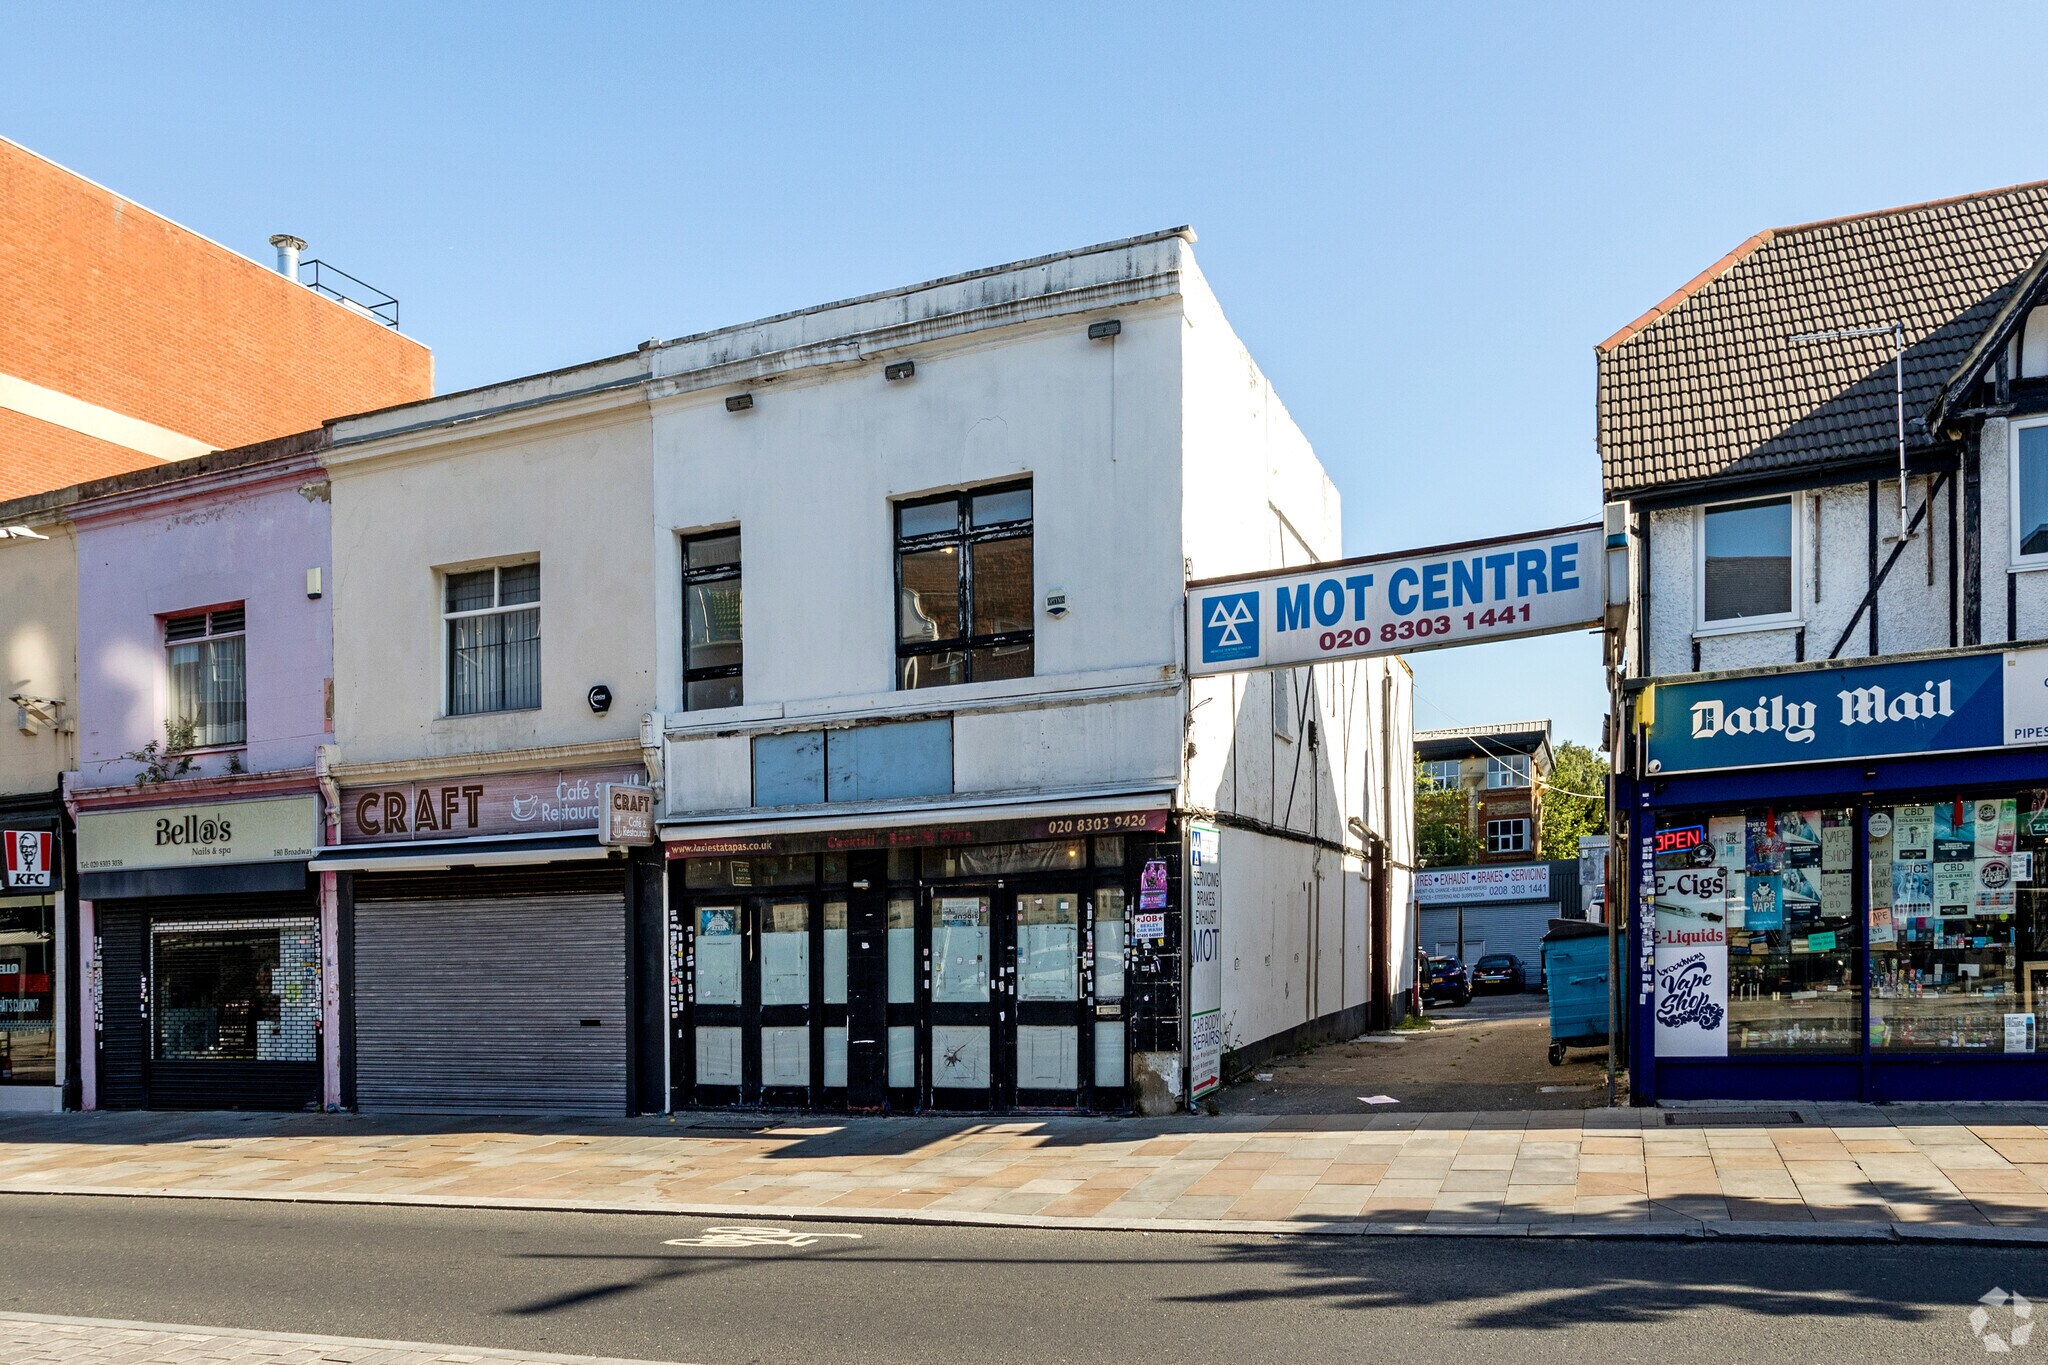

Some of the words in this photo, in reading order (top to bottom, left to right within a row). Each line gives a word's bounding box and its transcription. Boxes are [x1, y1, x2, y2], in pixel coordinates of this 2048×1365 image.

[1276, 574, 1373, 632] MOT
[1388, 542, 1579, 616] CENTRE
[1319, 627, 1371, 650] 020
[1380, 615, 1451, 642] 8303
[1463, 603, 1531, 630] 1441
[1690, 695, 1817, 744] Daily
[1836, 679, 1955, 726] Mail
[2014, 726, 2048, 739] PIPES
[556, 779, 590, 801] Café
[356, 785, 483, 836] CRAFT
[542, 803, 600, 822] Restaura
[613, 793, 650, 813] CRAFT
[1903, 807, 1925, 816] CBD
[629, 816, 643, 828] Café
[642, 820, 647, 828] &
[671, 840, 772, 854] www.lasiestatapas.co.uk
[1049, 820, 1072, 834] 020
[1077, 817, 1109, 832] 8303
[1114, 814, 1147, 828] 9426
[192, 847, 211, 856] Nails
[212, 847, 217, 855] &
[218, 847, 232, 856] spa
[273, 849, 284, 857] 180
[284, 847, 312, 857] Broadway
[1824, 848, 1852, 863] SHOP
[1415, 874, 1433, 887] YRES
[1440, 872, 1470, 886] EXHAUST
[1477, 869, 1503, 884] BRAKES
[1510, 867, 1547, 882] SERVICING
[1943, 863, 1965, 872] CBD
[14, 873, 44, 885] KFC
[1193, 870, 1220, 888] SERVICING
[1655, 874, 1724, 899] E-Cigs
[1196, 890, 1216, 907] BRAKES
[1489, 885, 1508, 896] 0208
[1511, 884, 1526, 895] 303
[1528, 883, 1547, 893] 1441
[1752, 901, 1776, 913] VAPE
[1140, 915, 1158, 923] JOB
[1195, 909, 1217, 925] EXHAUST
[1193, 928, 1220, 963] MOT
[1655, 928, 1723, 946] E-Liquids
[1656, 952, 1706, 977] broadway
[1661, 962, 1712, 998] Vape
[1660, 990, 1710, 1016] Shop
[1193, 1018, 1204, 1035] CAR
[1205, 1013, 1219, 1032] BODY
[1192, 1030, 1220, 1052] REPAIRS
